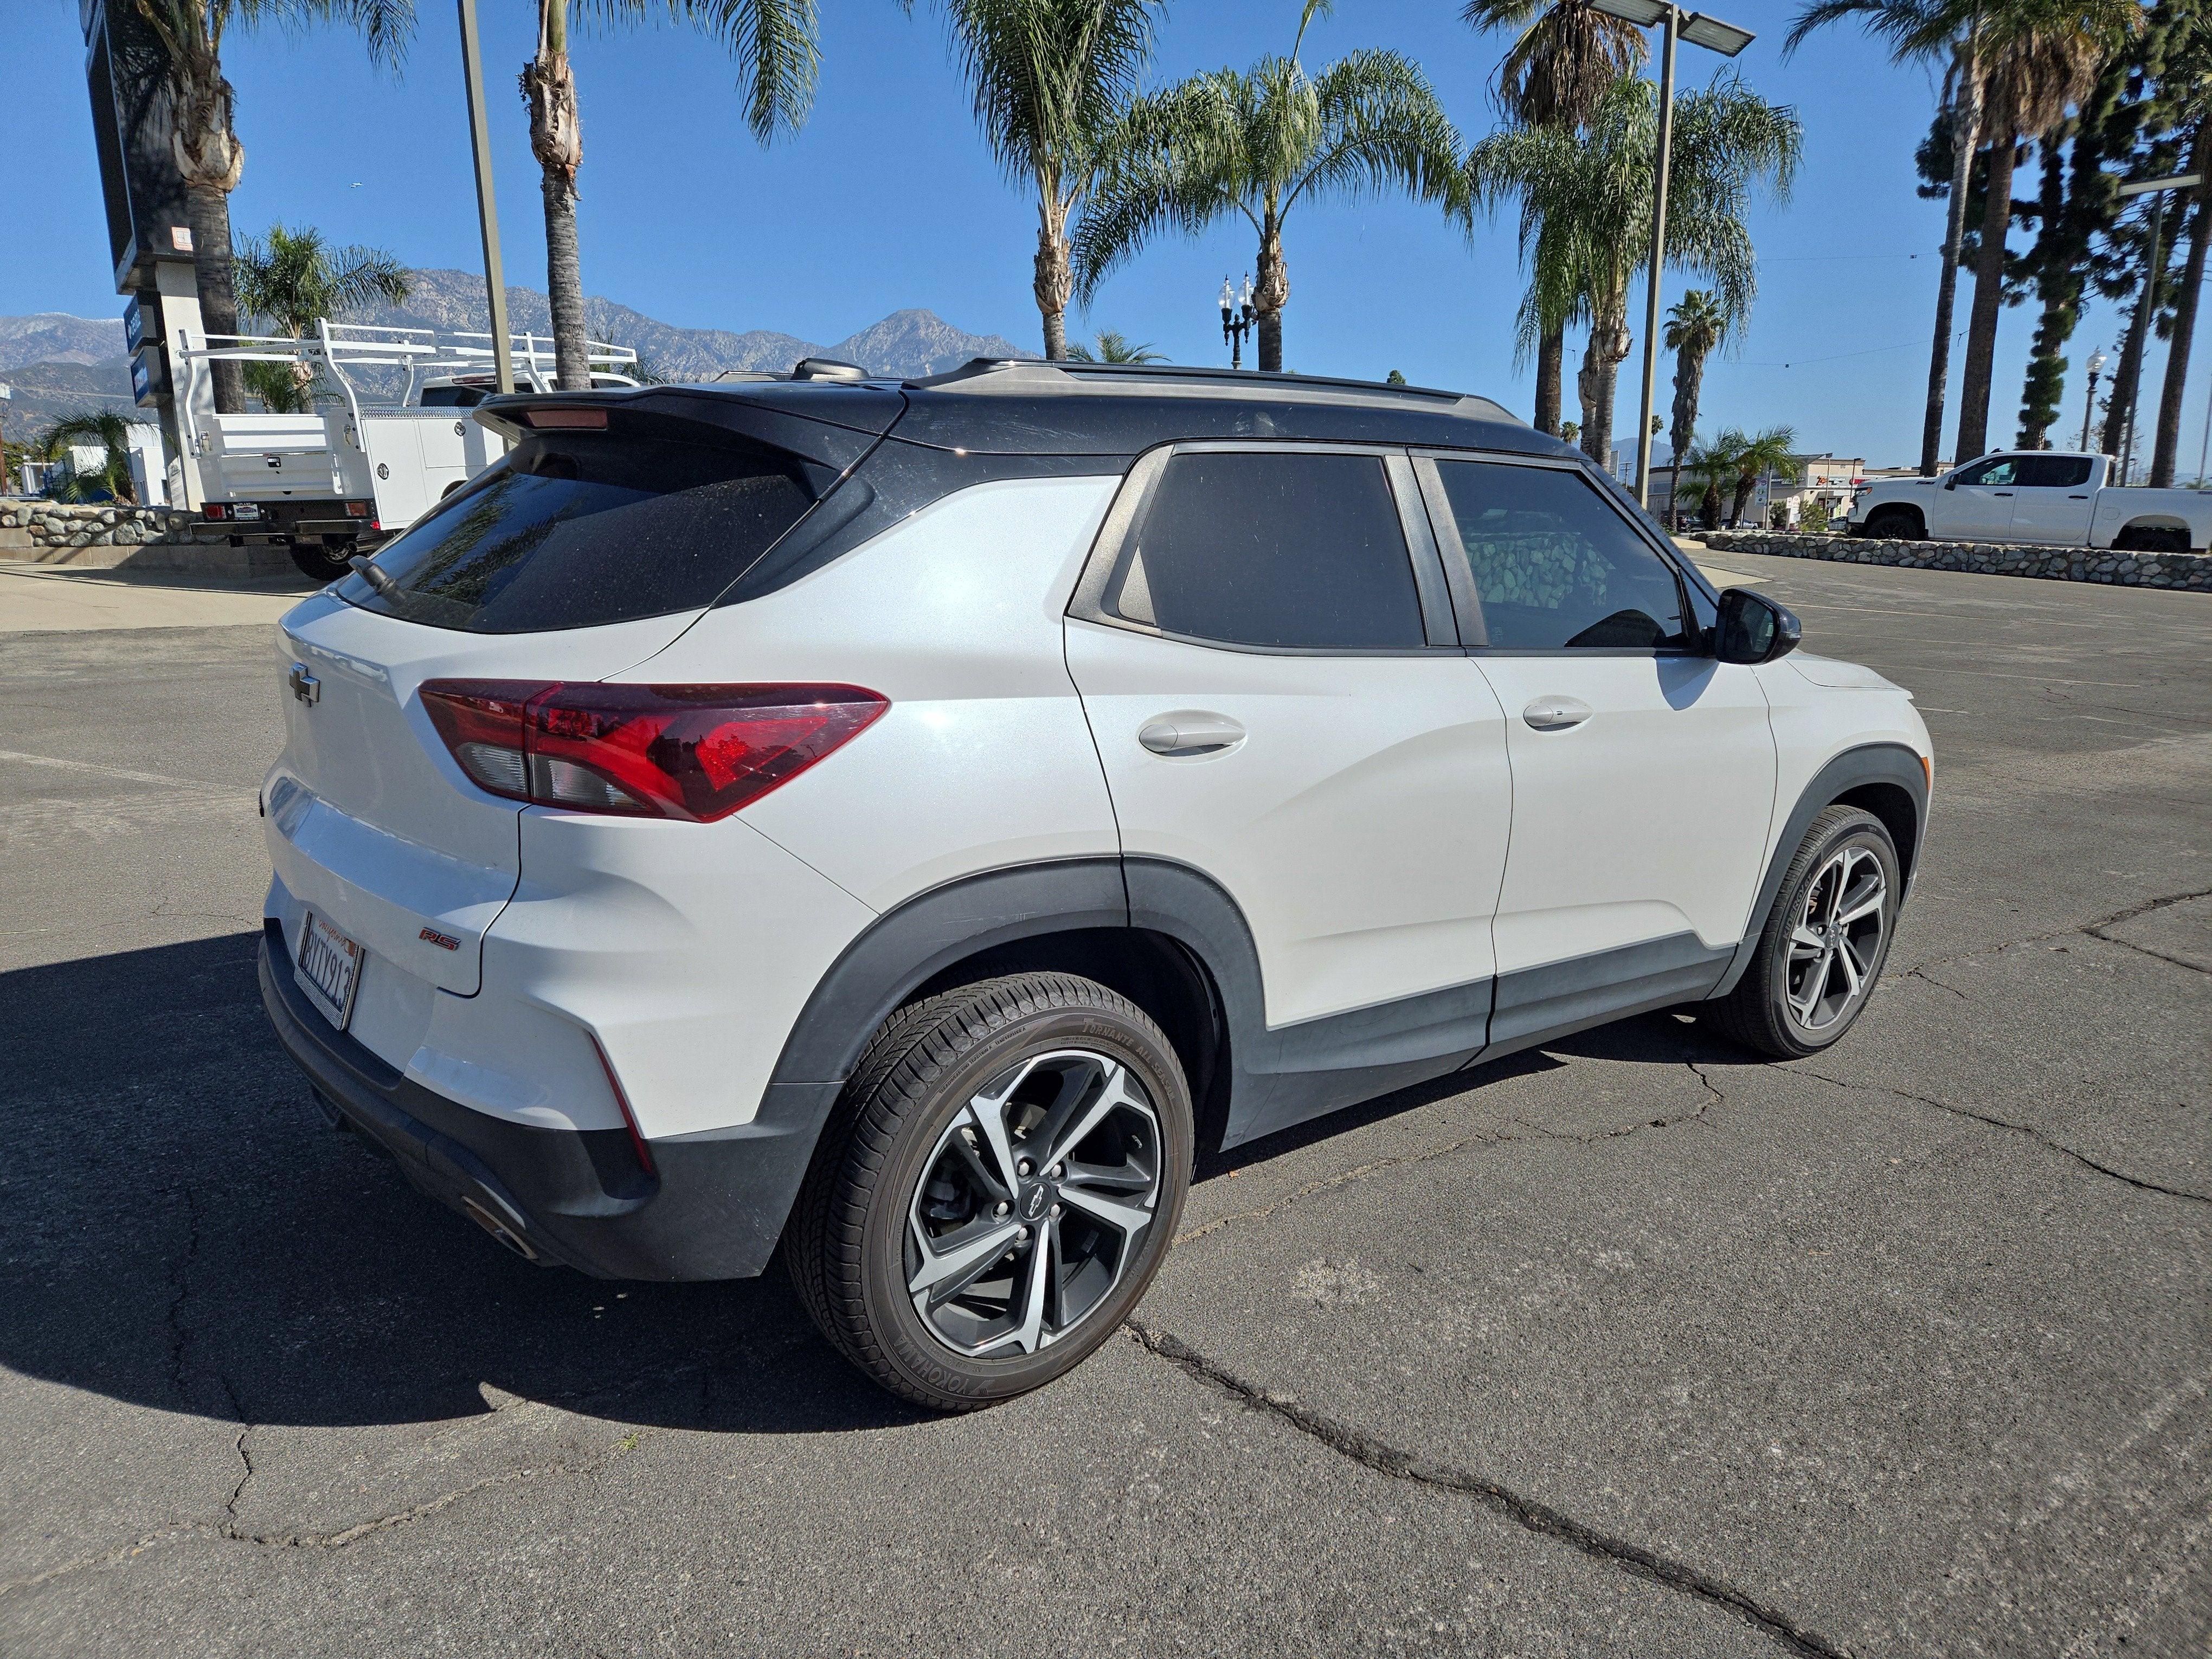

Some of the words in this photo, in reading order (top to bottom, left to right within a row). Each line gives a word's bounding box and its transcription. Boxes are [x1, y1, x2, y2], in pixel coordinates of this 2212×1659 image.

[418, 927, 461, 951] RS
[1135, 1045, 1154, 1064] ALL
[893, 1334, 970, 1395] YOKOHAMA
